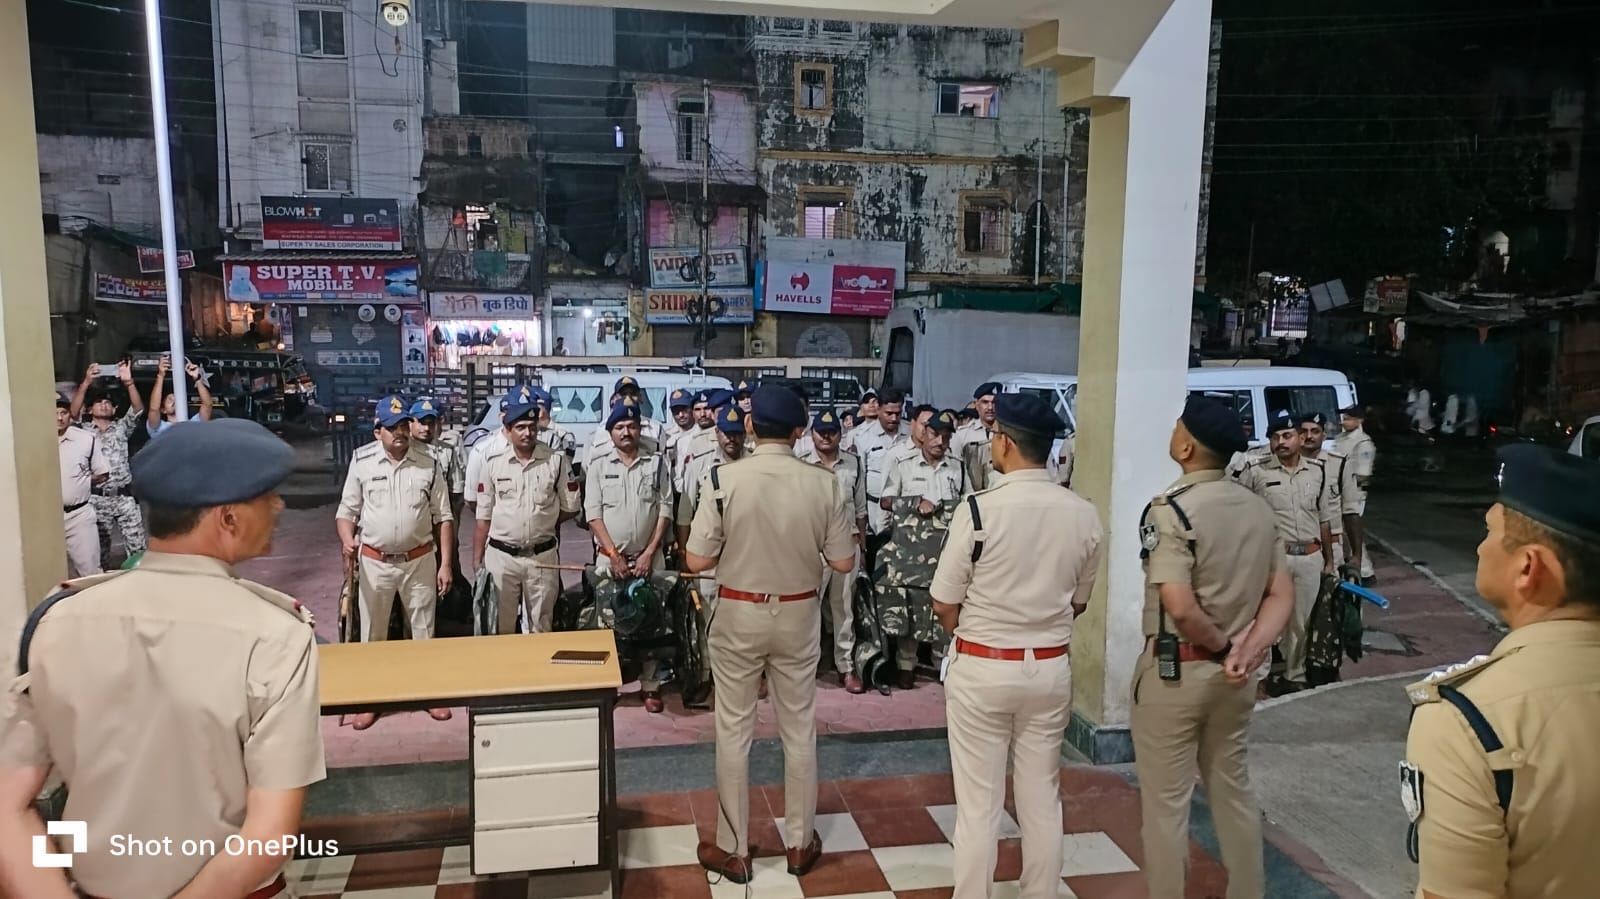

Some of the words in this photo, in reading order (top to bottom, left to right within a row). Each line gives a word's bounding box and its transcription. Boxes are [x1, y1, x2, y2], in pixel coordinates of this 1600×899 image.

[337, 241, 384, 249] CORPORATION
[256, 265, 332, 280] SUPER
[337, 265, 383, 280] T.V.
[287, 279, 354, 291] MOBILE
[481, 299, 502, 313] बुक
[504, 296, 528, 311] डिपो
[775, 293, 822, 305] HAVELLS
